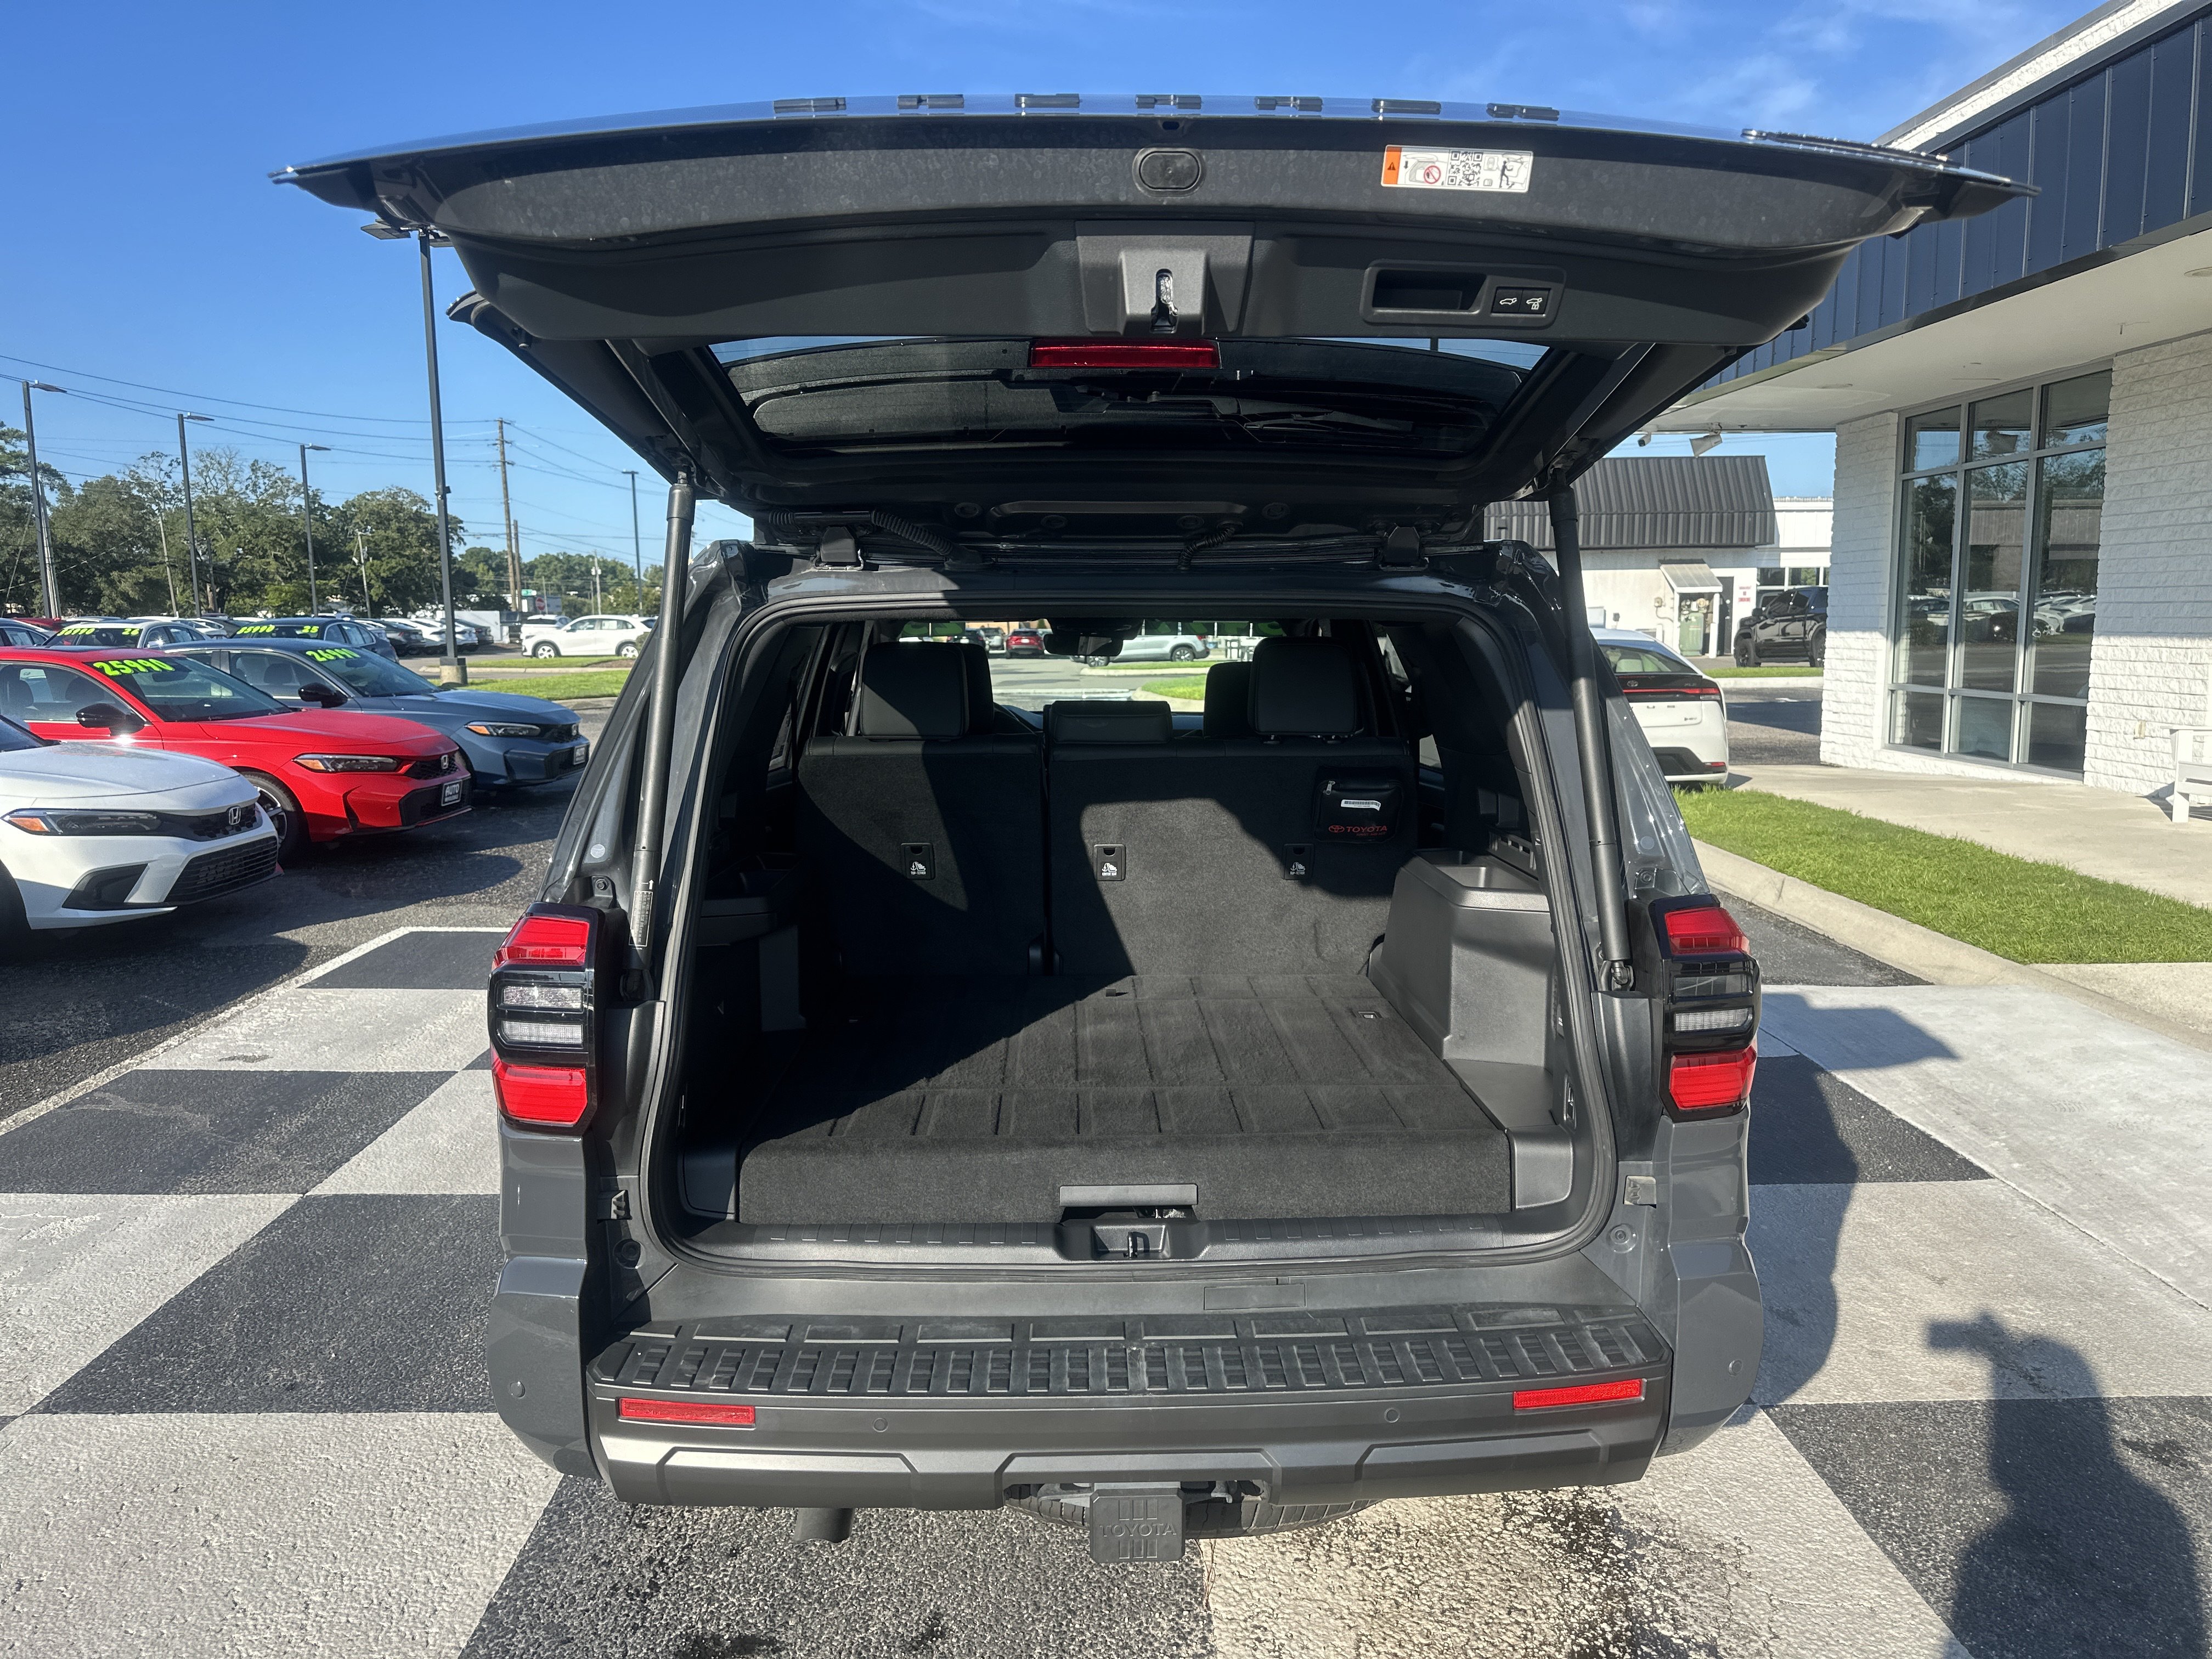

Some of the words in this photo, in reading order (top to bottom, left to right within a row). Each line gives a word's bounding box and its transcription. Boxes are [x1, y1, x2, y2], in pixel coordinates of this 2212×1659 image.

[306, 648, 362, 662] 26990
[93, 658, 176, 676] 25990
[445, 783, 460, 797] AUTO
[1099, 1522, 1177, 1537] TOYOTA
